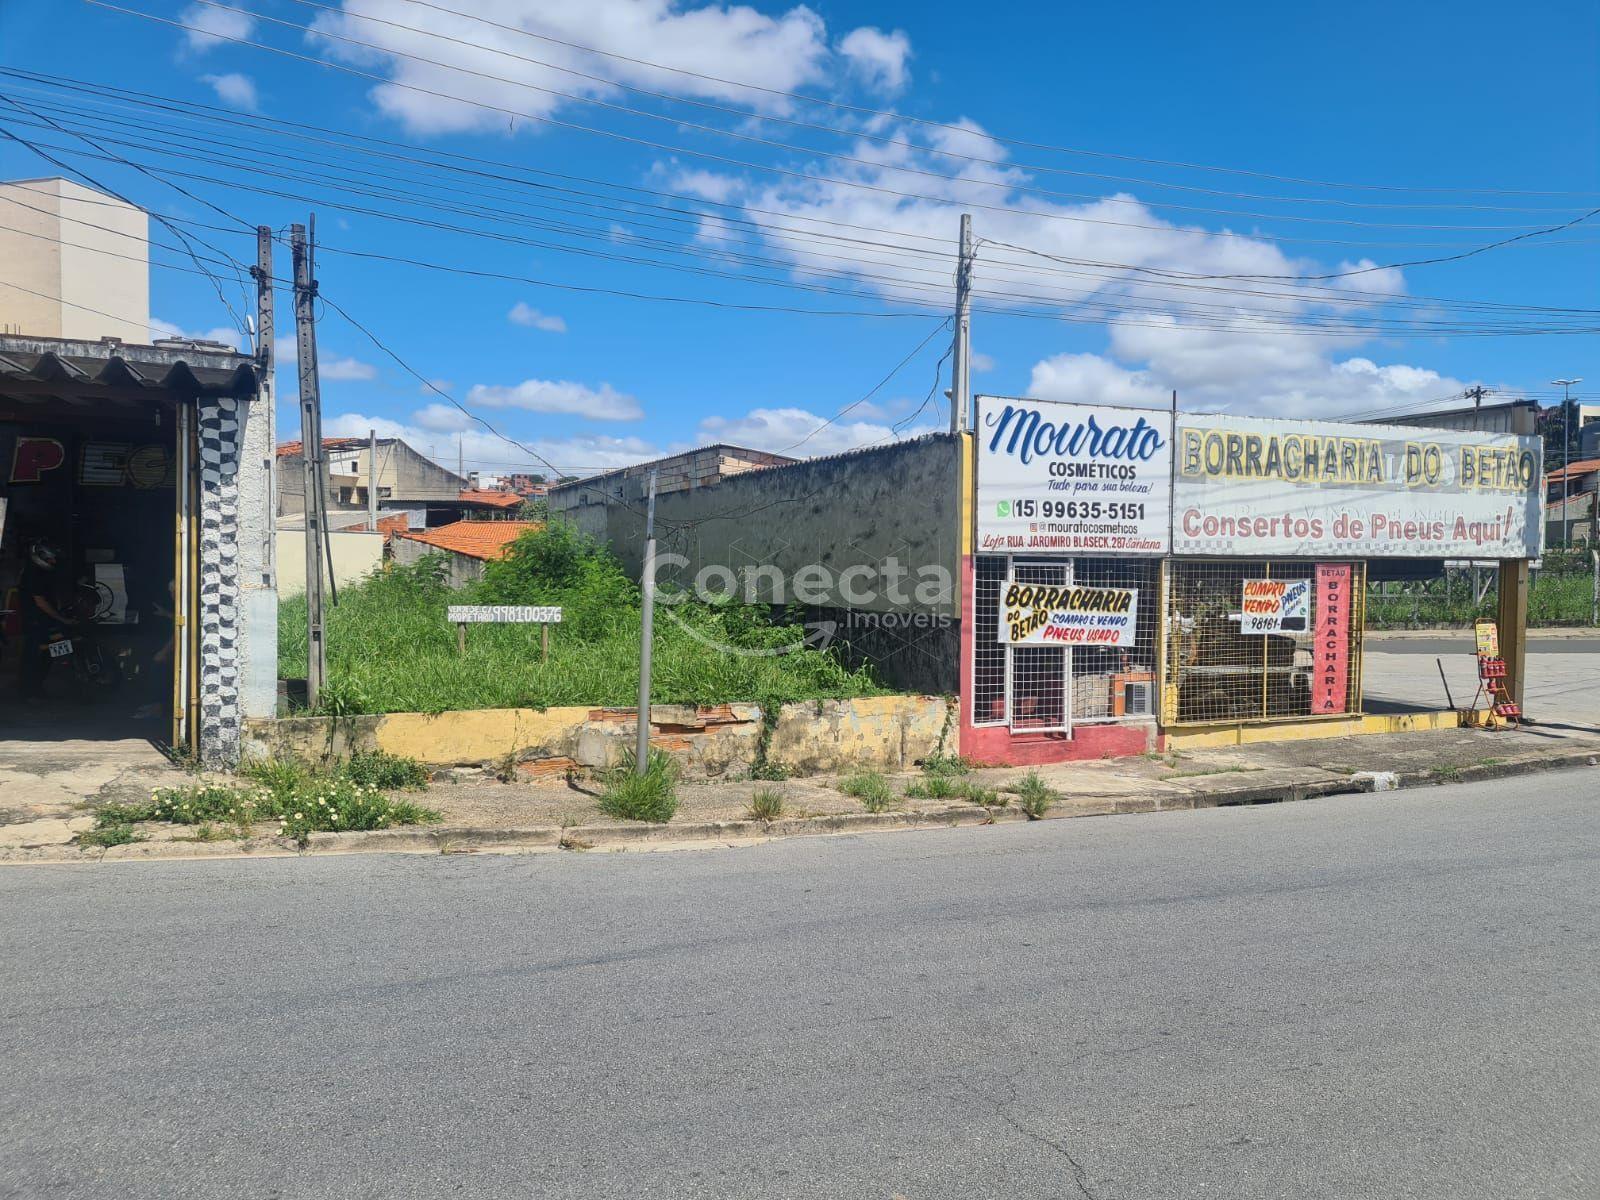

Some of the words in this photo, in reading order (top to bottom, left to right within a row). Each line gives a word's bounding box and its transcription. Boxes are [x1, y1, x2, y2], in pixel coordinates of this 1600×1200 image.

[986, 406, 1166, 465] Mourato
[1181, 428, 1384, 484] BORRACHARIA
[1405, 442, 1441, 487] DO
[1459, 444, 1536, 490] BETÃO
[1048, 460, 1137, 480] COSMÉTICOS
[1048, 480, 1070, 491] Tudo
[1073, 482, 1098, 496] para
[1102, 483, 1117, 492] sua
[1119, 482, 1154, 495] beleza!
[1012, 499, 1039, 518] (15)
[1042, 501, 1145, 520] 99635-5151
[1183, 508, 1324, 541] Consertos
[1332, 513, 1364, 541] de
[1371, 514, 1444, 542] Pneus
[1452, 505, 1514, 547] Aqui!
[1027, 536, 1071, 548] JAROMIRO
[1005, 584, 1132, 613] BORRACHARIA
[1244, 582, 1286, 598] COMPRO
[1281, 580, 1307, 610] PNEUS
[1007, 610, 1020, 622] DO
[1244, 599, 1281, 614] VENDO
[1011, 608, 1048, 641] BETÃO
[1052, 613, 1088, 625] COMPRO
[1089, 615, 1095, 625] E
[1097, 615, 1128, 627] VENDO
[1043, 625, 1085, 641] PNEUS
[1086, 628, 1120, 643] USADO
[1323, 581, 1339, 709] BORRACHARIA
